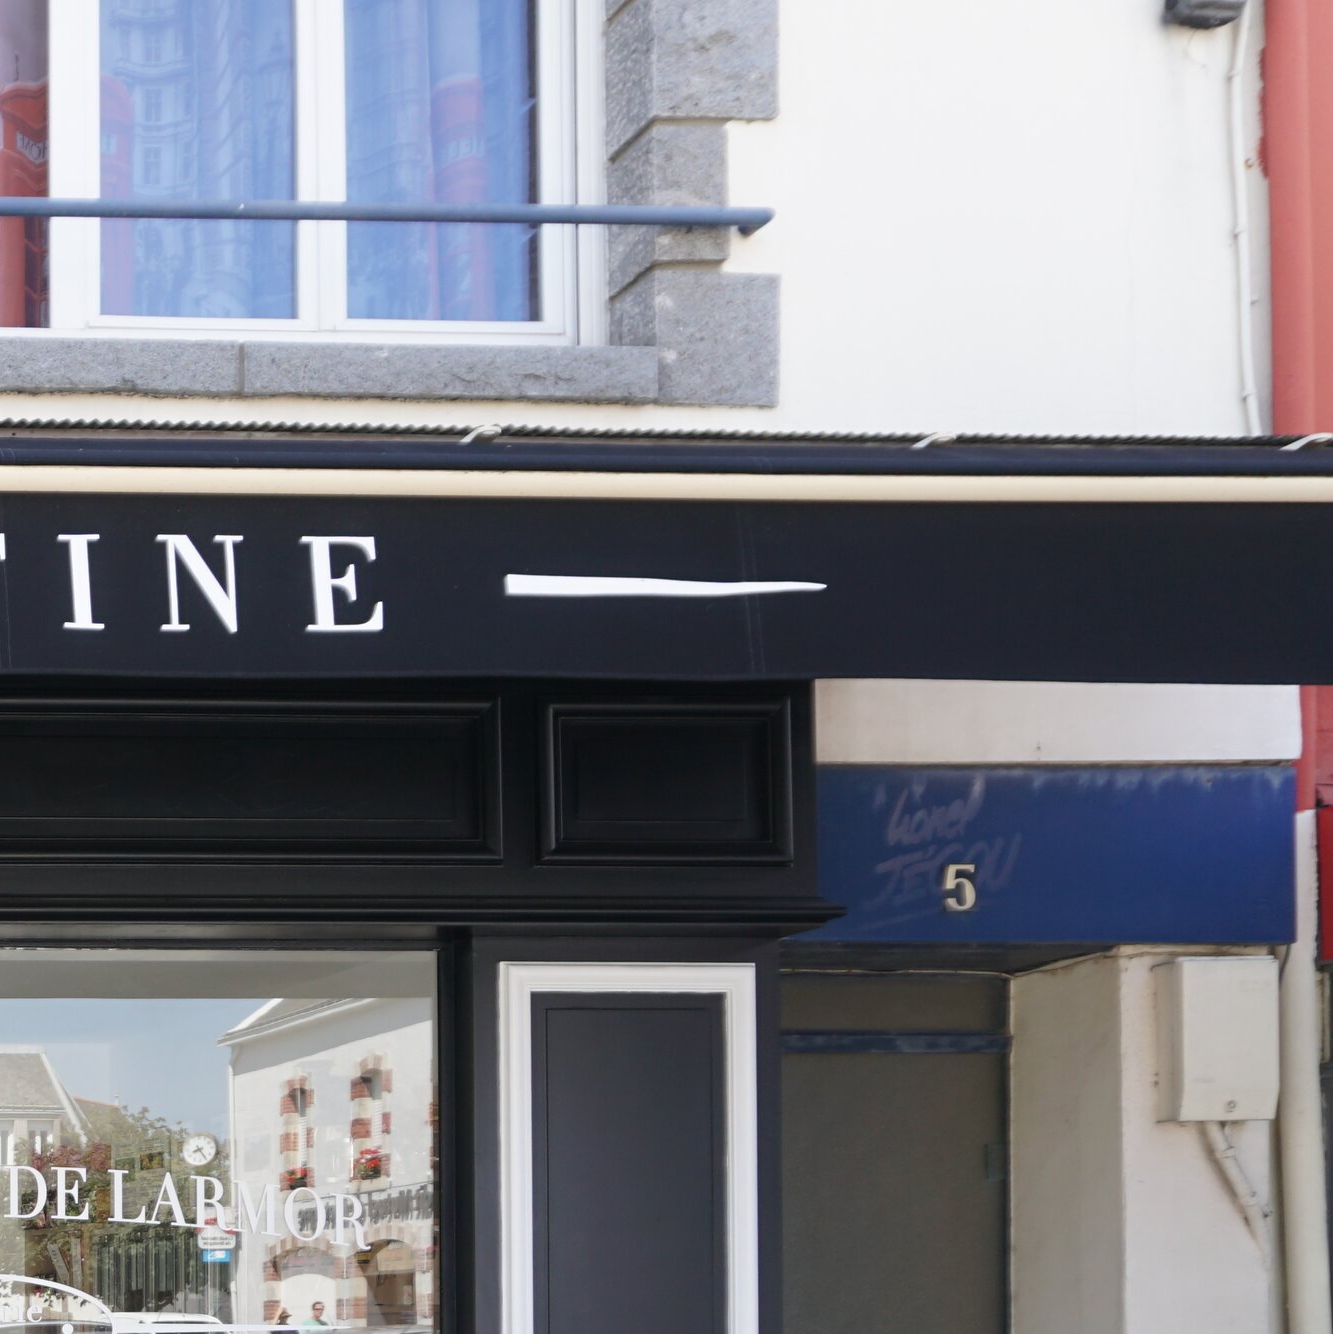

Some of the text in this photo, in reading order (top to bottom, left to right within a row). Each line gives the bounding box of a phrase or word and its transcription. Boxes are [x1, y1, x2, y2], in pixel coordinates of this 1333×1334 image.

[945, 864, 976, 911] 5
[3, 1165, 90, 1221] DE
[107, 1168, 371, 1251] LARMOR
